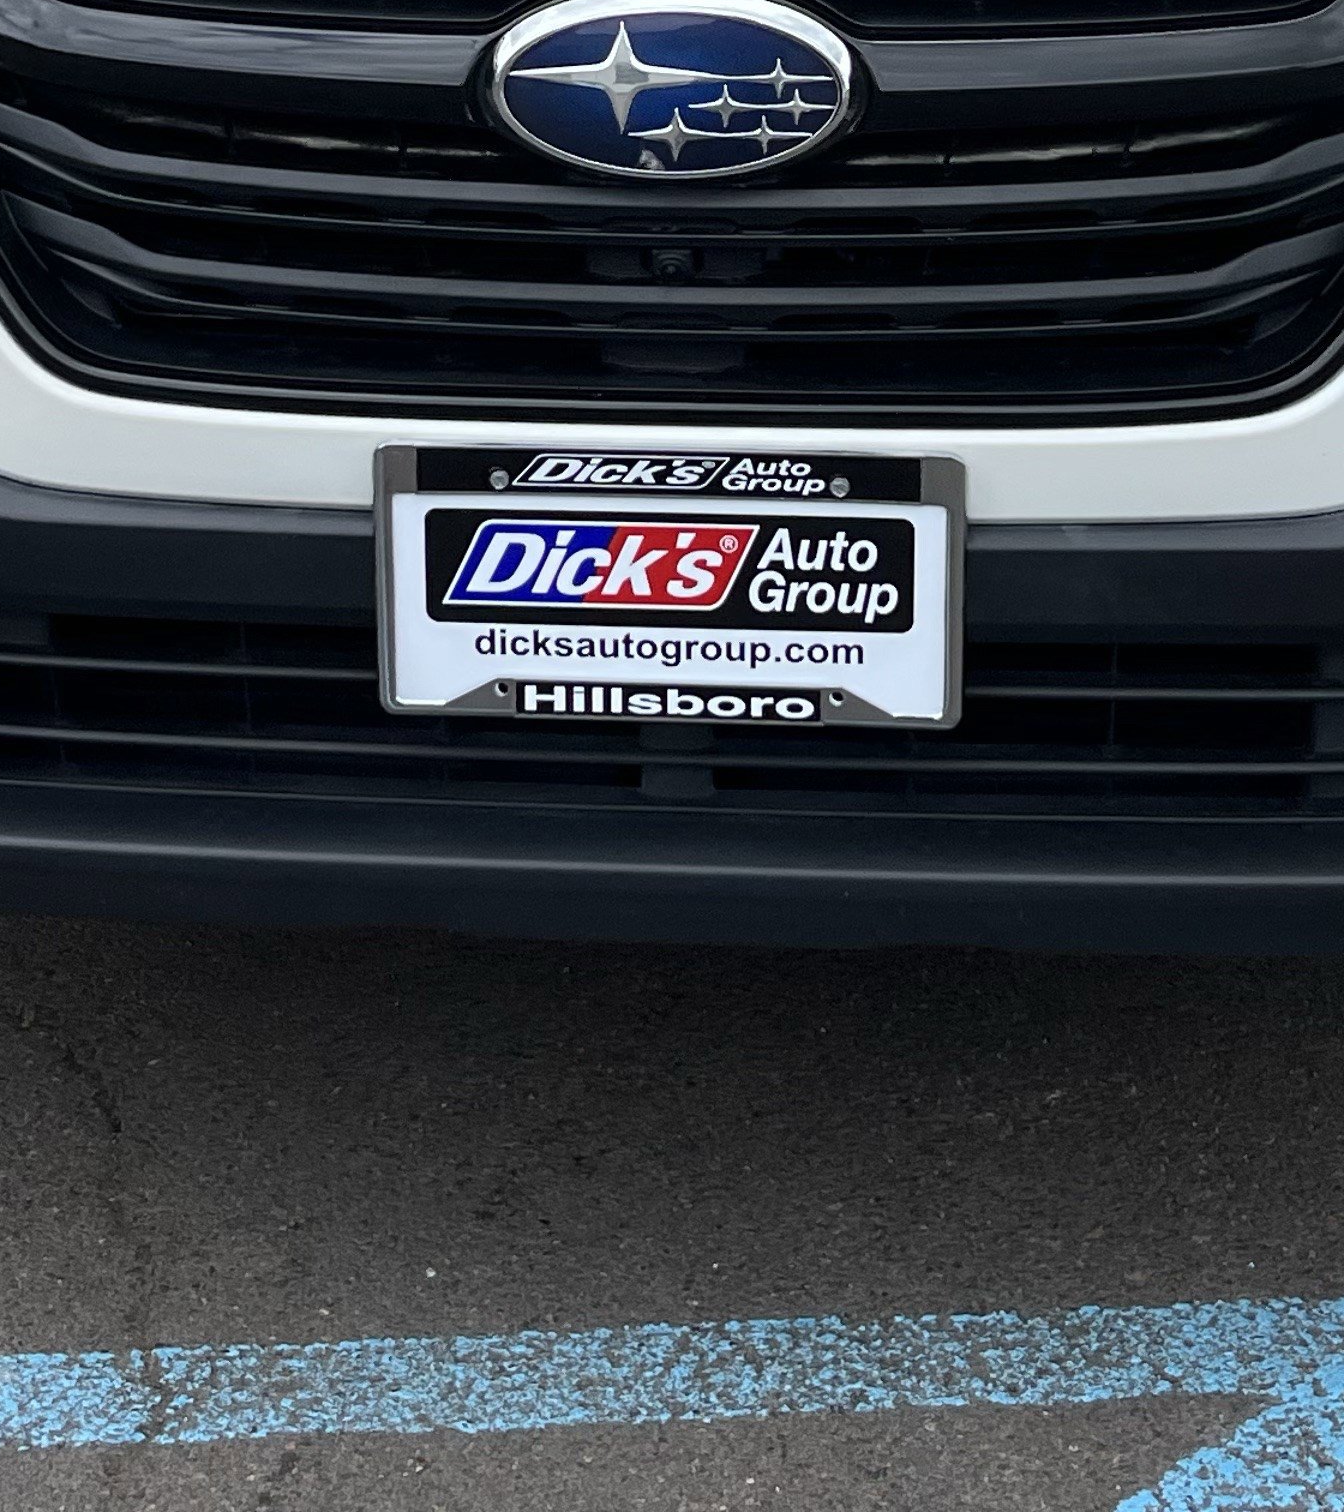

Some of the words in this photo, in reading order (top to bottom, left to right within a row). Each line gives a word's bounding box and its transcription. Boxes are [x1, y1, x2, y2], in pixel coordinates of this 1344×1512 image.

[722, 474, 826, 496] Group
[729, 457, 811, 477] Auto
[757, 527, 878, 573] Auto
[749, 571, 899, 624] Group
[474, 628, 865, 668] dicksautogroup.com
[523, 683, 815, 719] Hillsboro
